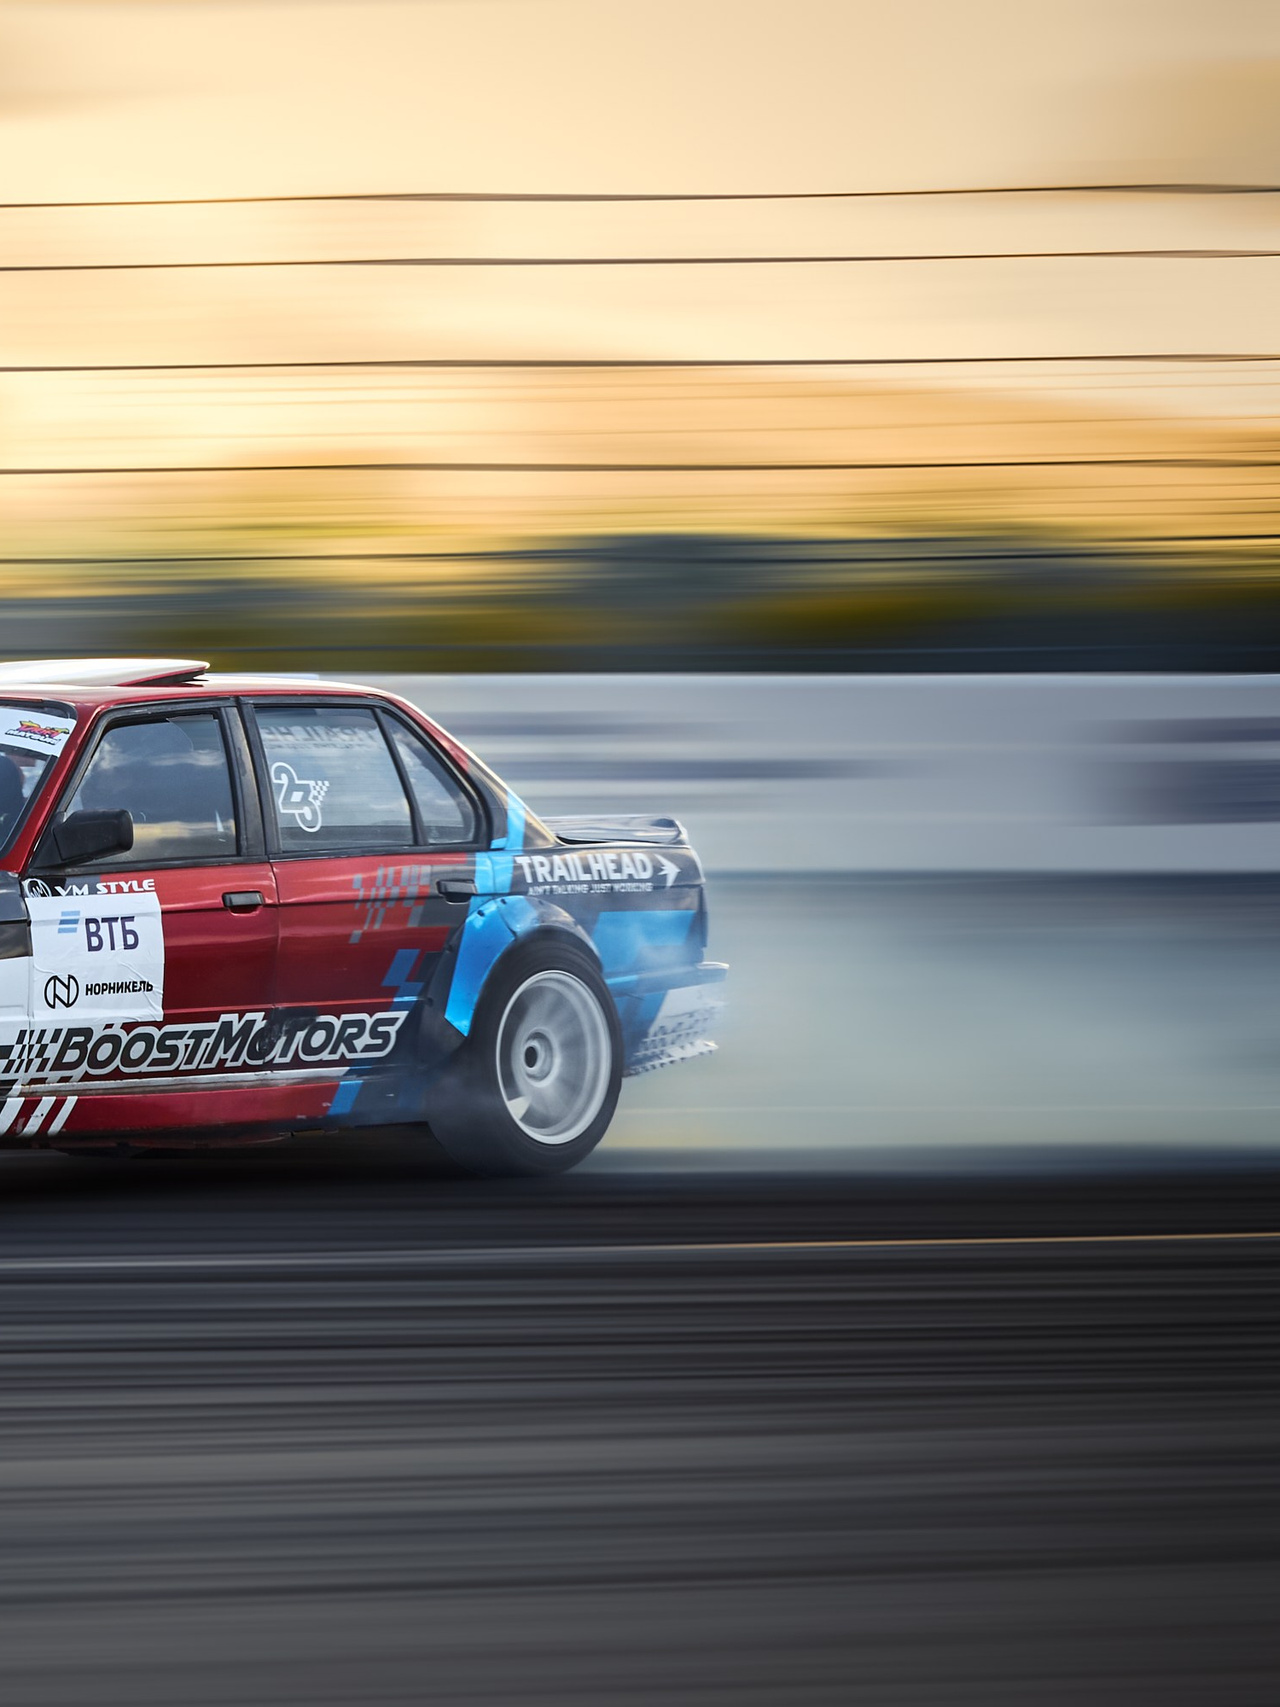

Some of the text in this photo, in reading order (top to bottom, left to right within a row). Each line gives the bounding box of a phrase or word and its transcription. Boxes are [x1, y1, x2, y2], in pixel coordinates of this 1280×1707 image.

[515, 852, 653, 883] TRAILHEAD
[54, 883, 89, 896] VM
[96, 878, 155, 895] STYLE
[85, 915, 139, 952] ВТБ
[85, 980, 153, 996] НОРНИКЕЛЬ
